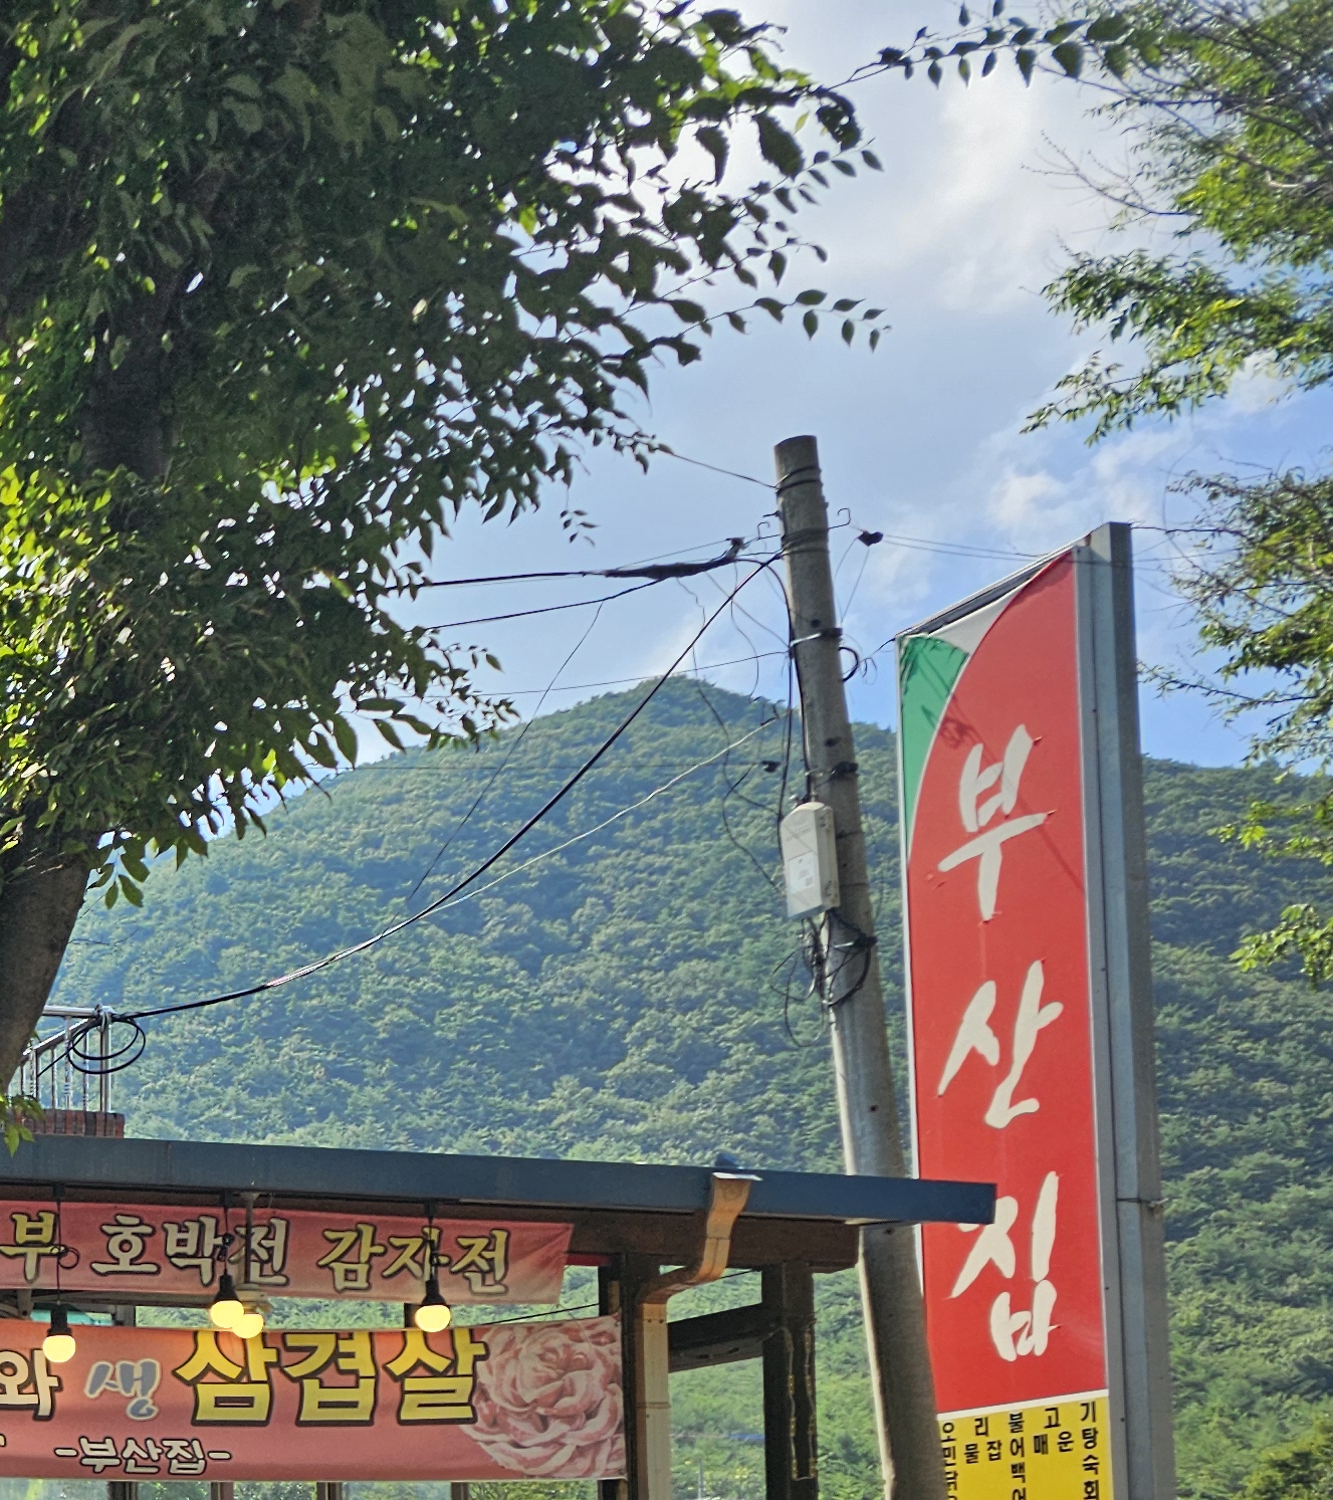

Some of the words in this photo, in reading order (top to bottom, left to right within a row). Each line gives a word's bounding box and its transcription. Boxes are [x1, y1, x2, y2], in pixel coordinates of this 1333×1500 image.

[938, 724, 1062, 1362] 부산집
[91, 1212, 291, 1288] 호박전
[321, 1222, 510, 1296] 감자전
[84, 1357, 161, 1421] 생
[172, 1328, 489, 1425] 삼겹살
[941, 1400, 1097, 1444] 오리불고기
[941, 1427, 1099, 1469] 민물잡어매운탕
